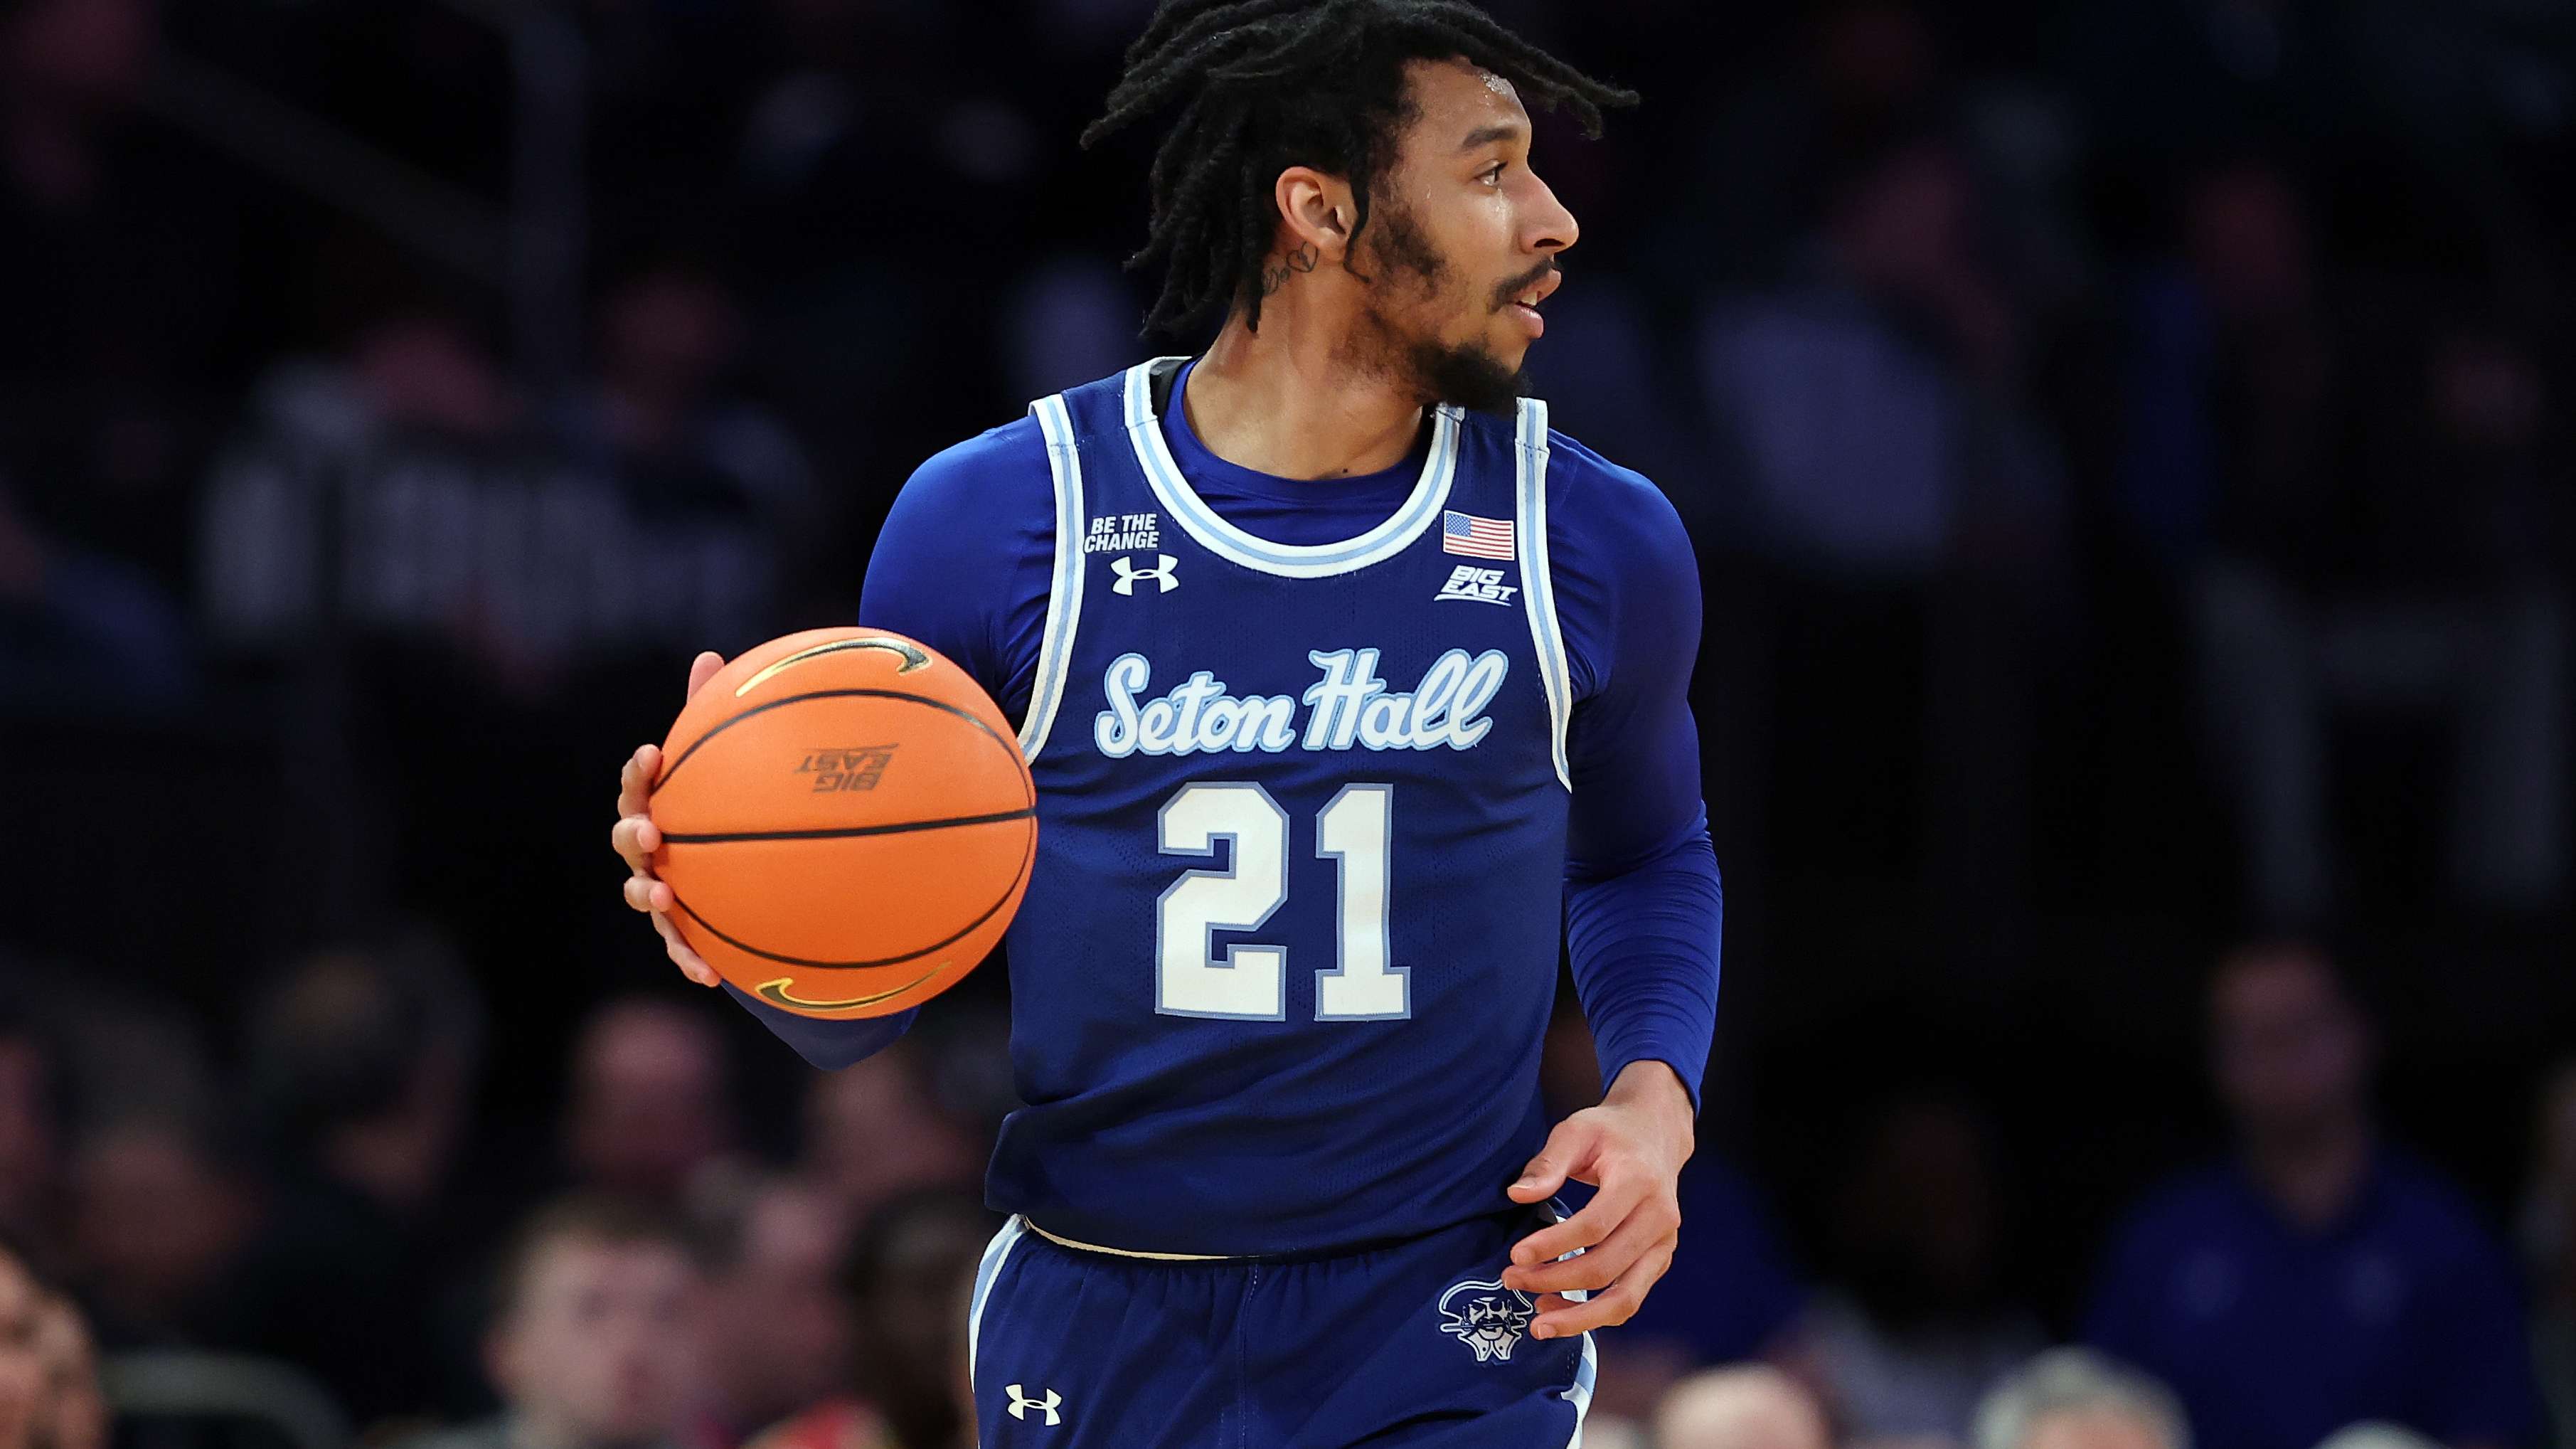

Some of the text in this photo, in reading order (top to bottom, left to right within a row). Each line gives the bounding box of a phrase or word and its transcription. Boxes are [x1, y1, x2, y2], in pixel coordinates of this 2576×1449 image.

[1091, 513, 1157, 534] BE THE
[1084, 531, 1160, 553] CHANGE
[1449, 565, 1505, 585] BIG
[1440, 579, 1518, 601] EAST
[1094, 648, 1509, 758] Seton Hall
[793, 750, 892, 775] EAST
[812, 773, 881, 792] BIG
[1154, 781, 1411, 1021] 21
